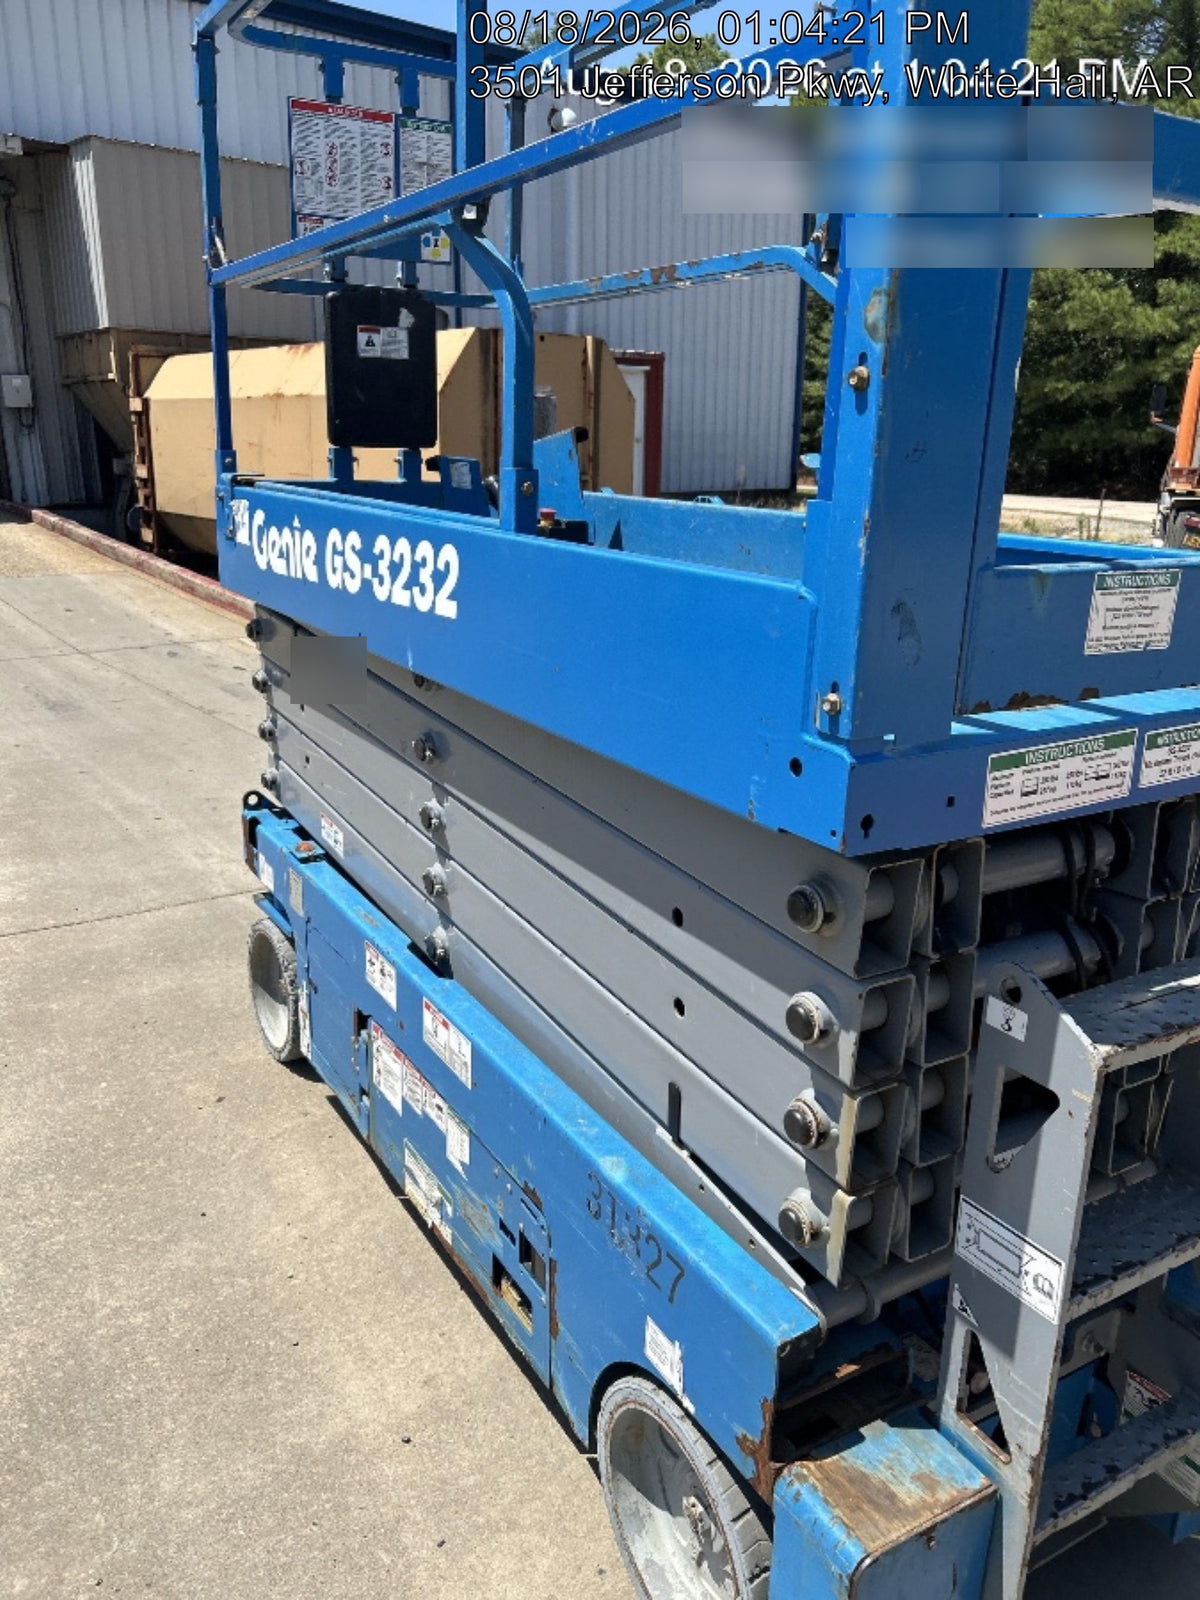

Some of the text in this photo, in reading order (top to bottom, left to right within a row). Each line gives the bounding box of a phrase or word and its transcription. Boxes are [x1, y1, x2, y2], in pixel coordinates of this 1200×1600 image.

[252, 508, 460, 619] Genie GS-3232
[1025, 739, 1105, 765] INSTRUCTIONS
